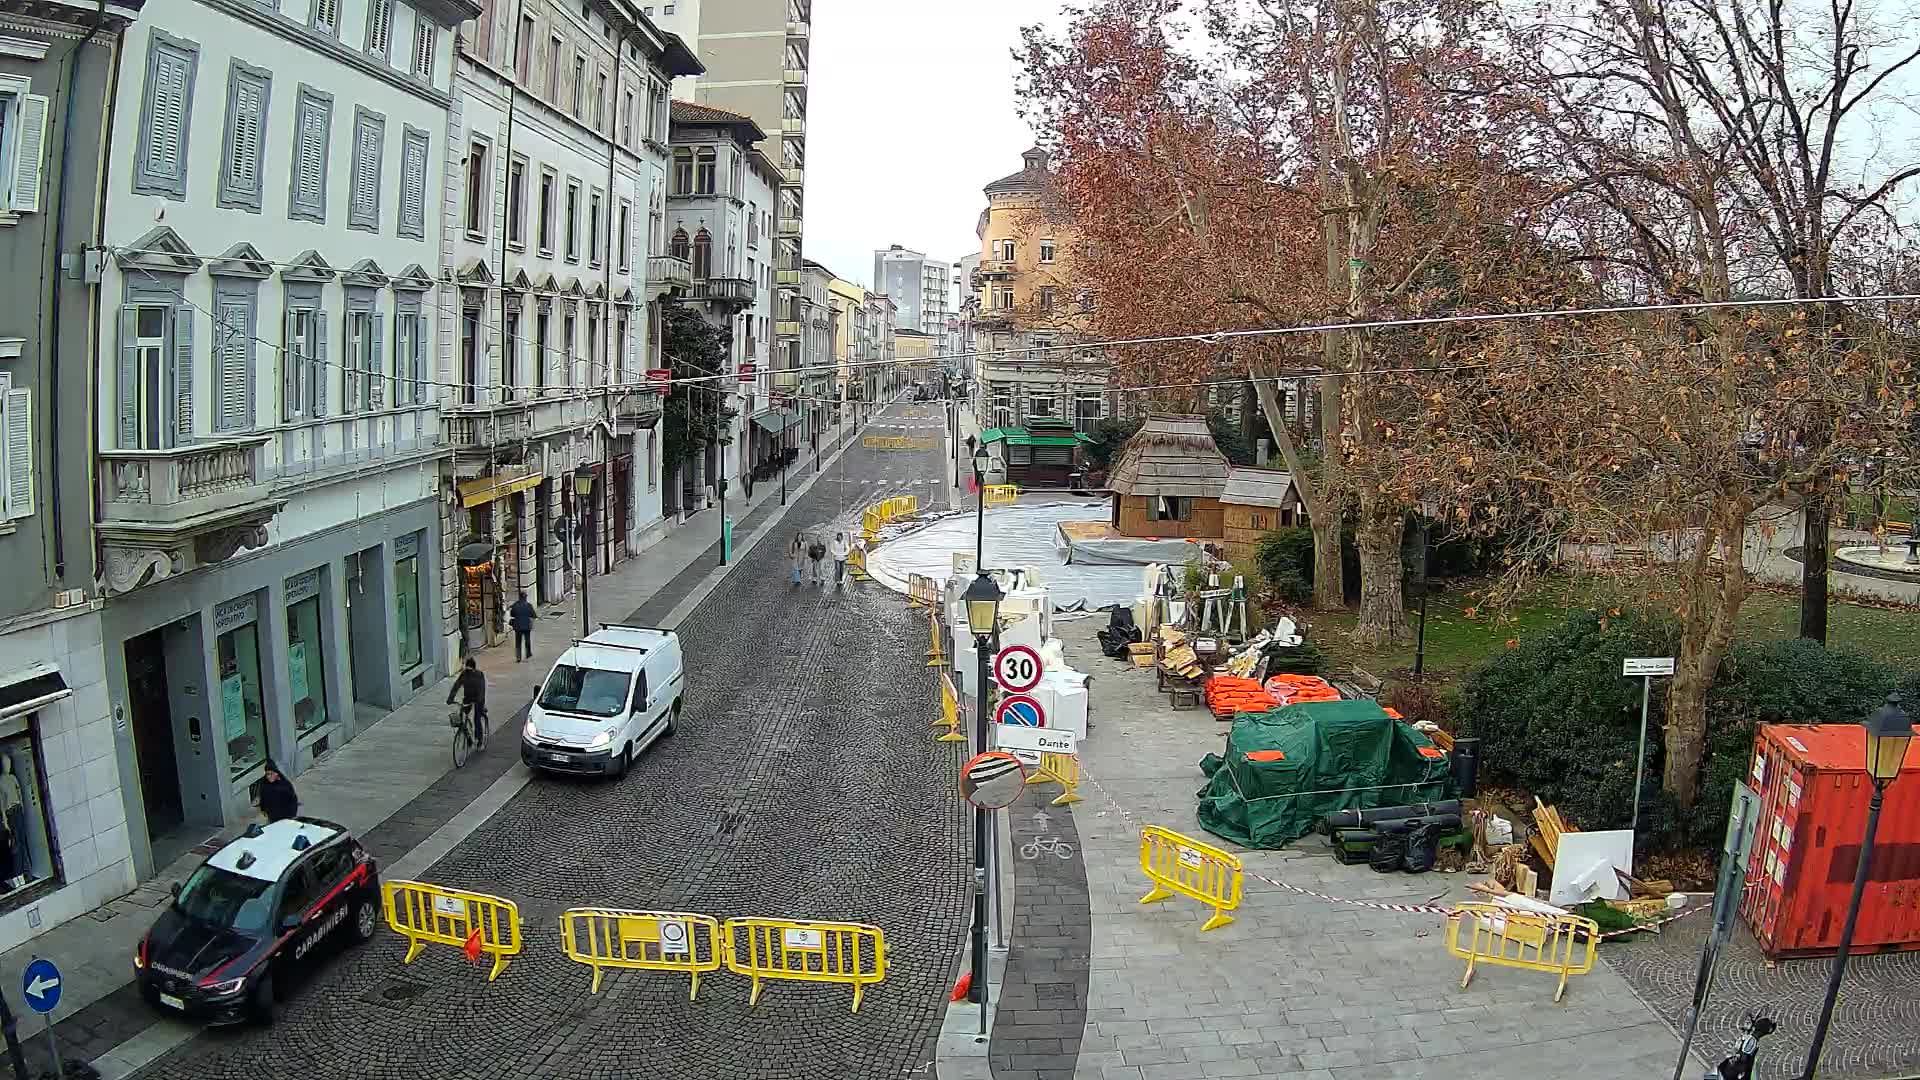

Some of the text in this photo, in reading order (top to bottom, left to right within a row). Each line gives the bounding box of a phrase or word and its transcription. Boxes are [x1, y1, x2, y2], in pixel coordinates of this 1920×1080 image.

[1005, 658, 1033, 680] 30
[1038, 737, 1070, 749] Dante
[295, 903, 348, 960] CARABINIERI
